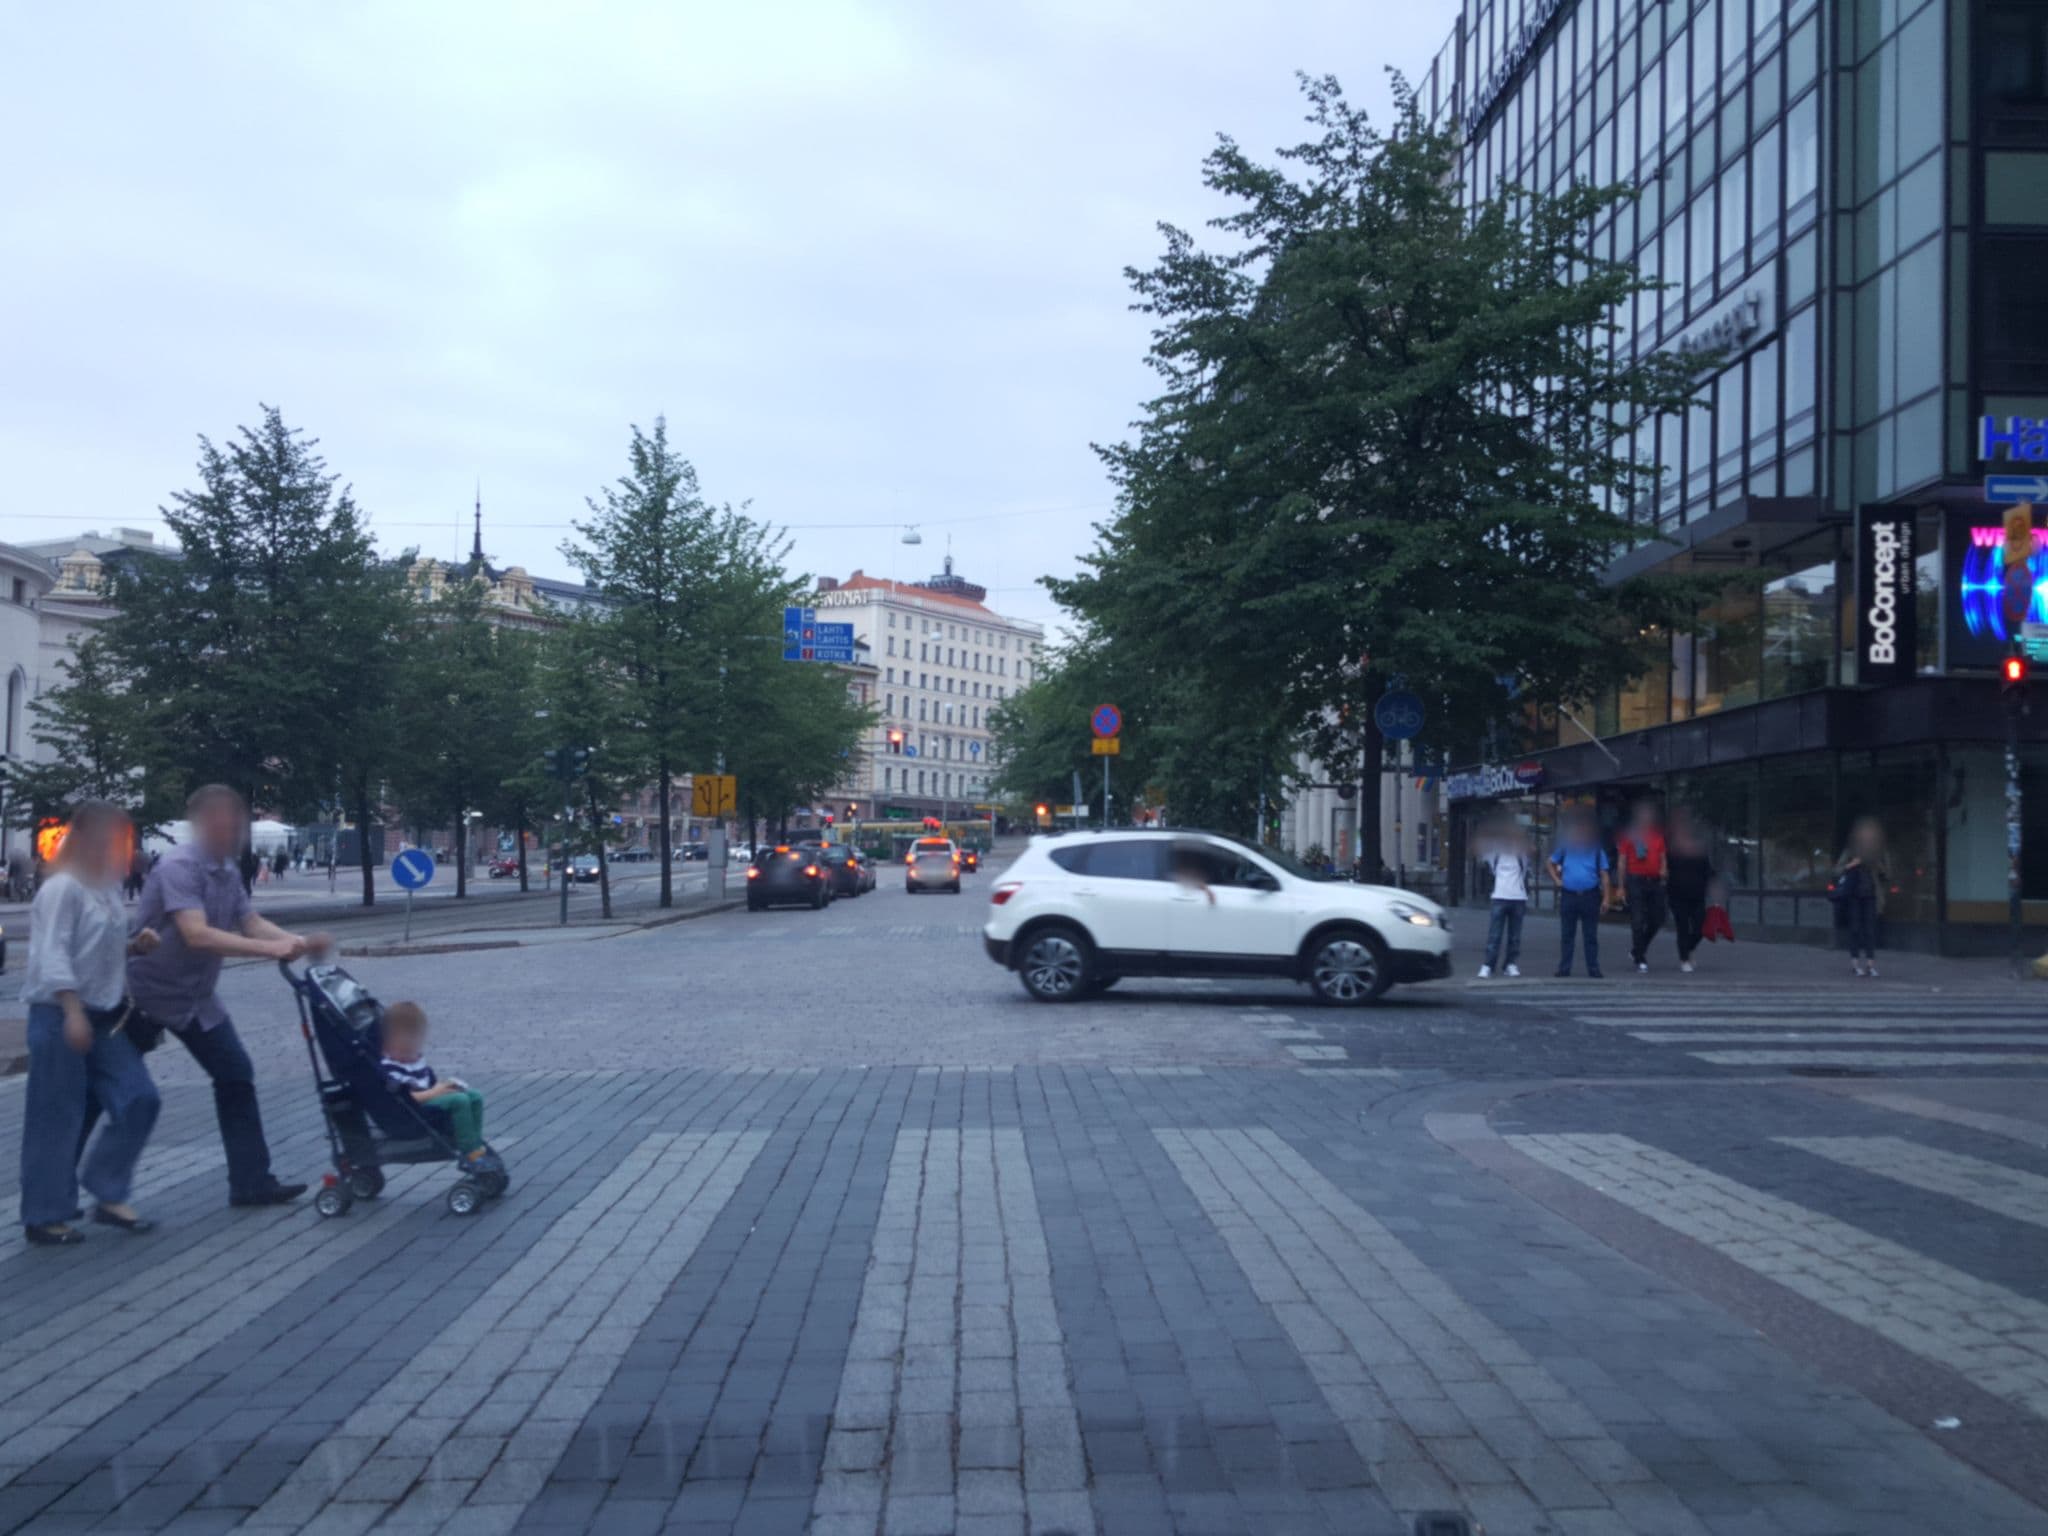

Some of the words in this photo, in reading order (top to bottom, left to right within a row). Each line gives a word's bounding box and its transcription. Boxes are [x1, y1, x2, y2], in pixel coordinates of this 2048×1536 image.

[1899, 522, 1912, 559] design
[1868, 521, 1902, 664] BoConcept
[1901, 561, 1910, 594] urban
[818, 625, 845, 634] LAHTI
